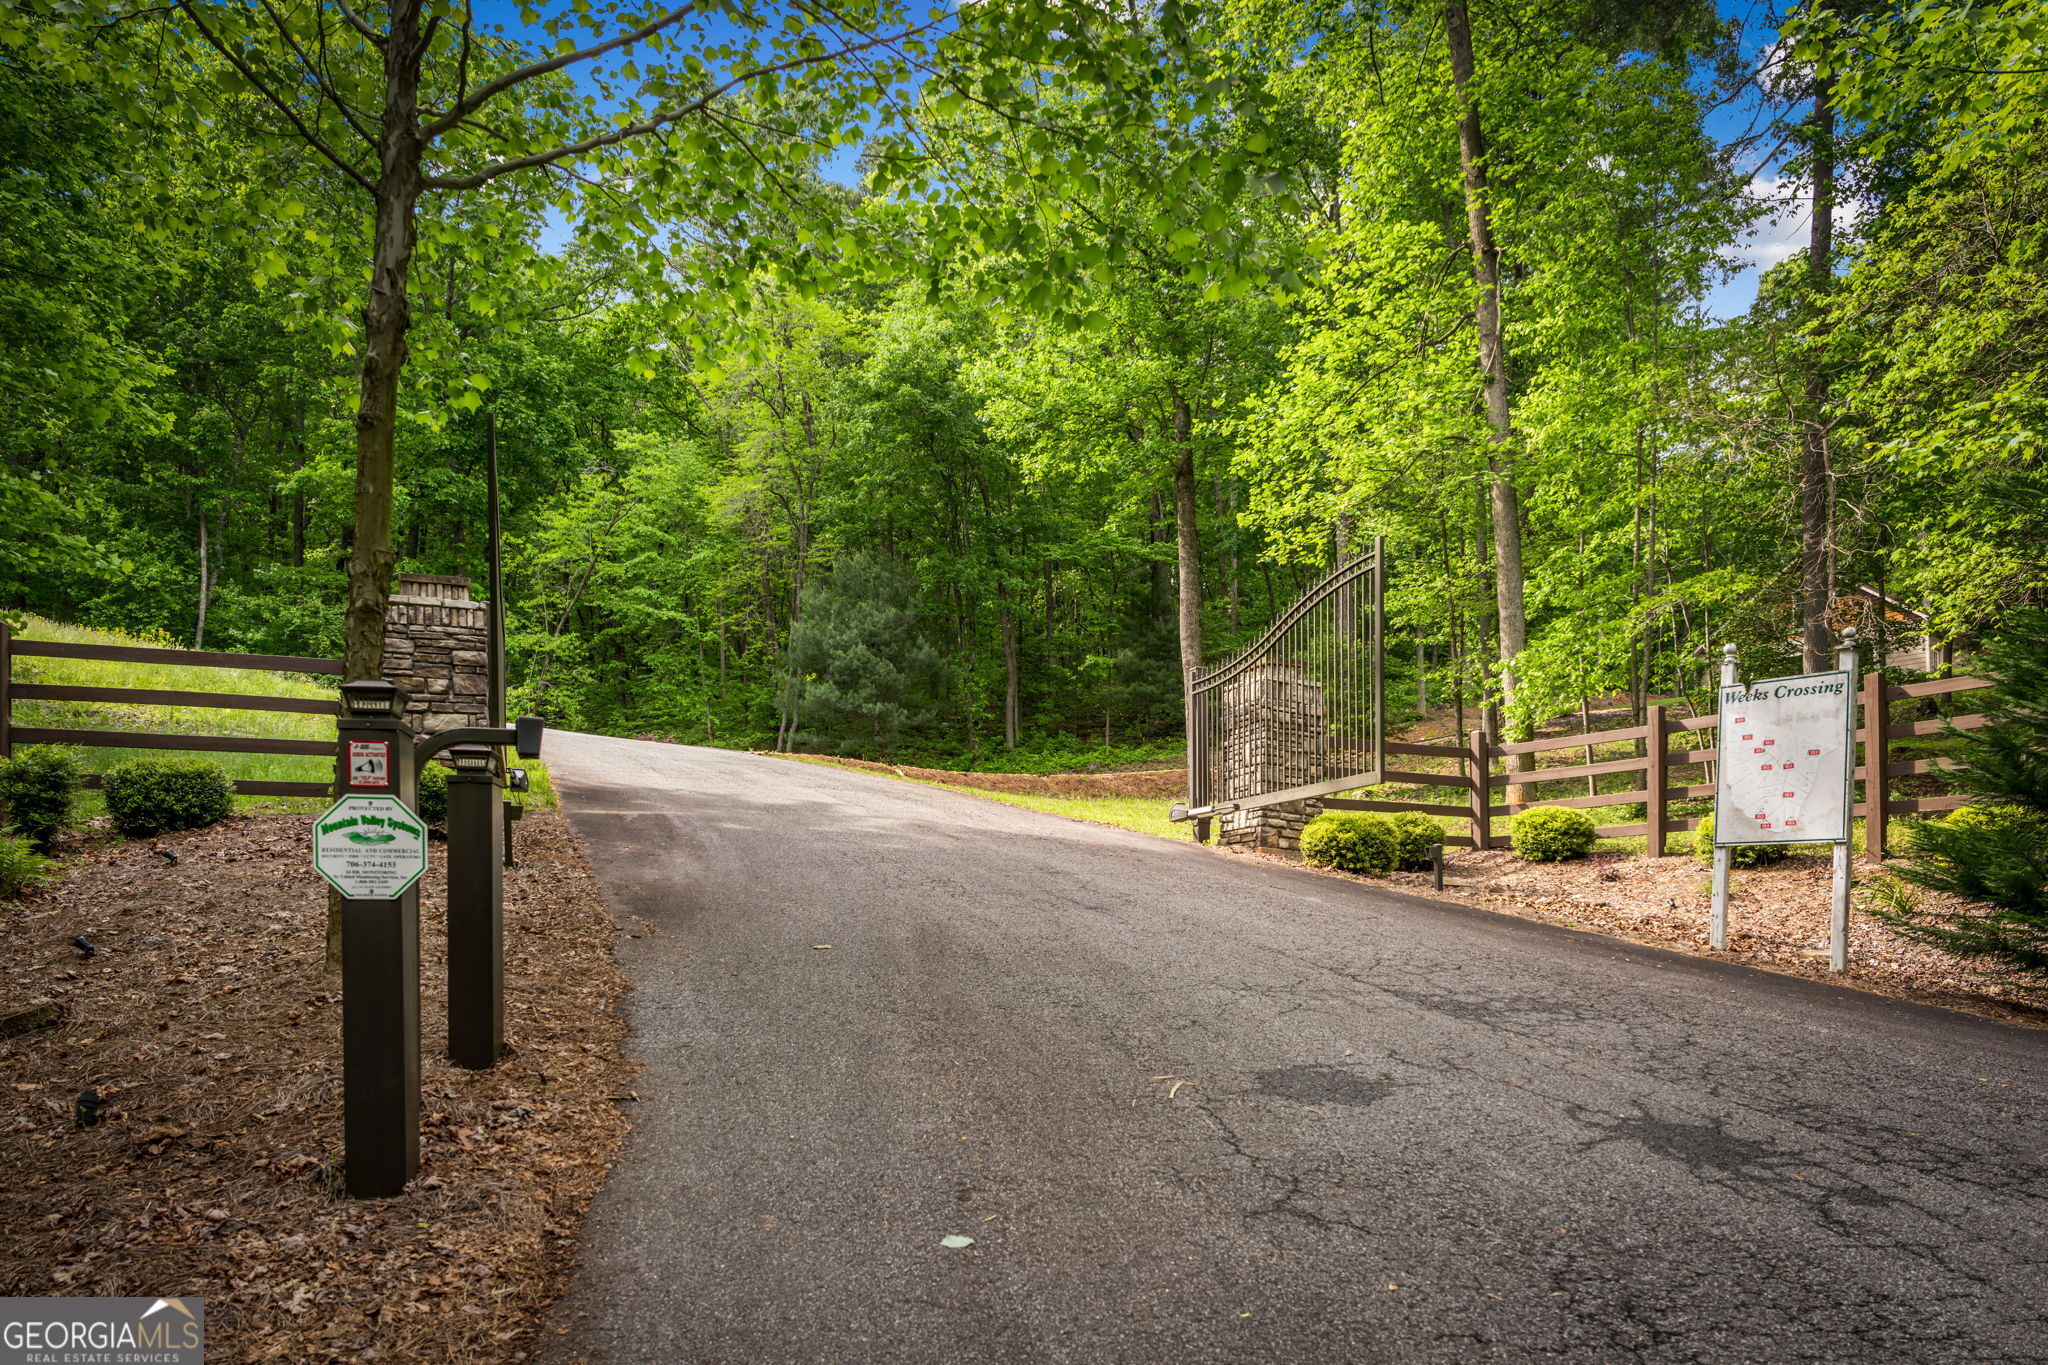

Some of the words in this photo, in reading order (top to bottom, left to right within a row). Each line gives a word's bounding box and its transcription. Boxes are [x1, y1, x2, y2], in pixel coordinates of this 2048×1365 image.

[1725, 689, 1769, 705] Weeks
[1774, 681, 1845, 699] Crossing
[320, 816, 359, 836] Mountain
[360, 815, 386, 828] Valley
